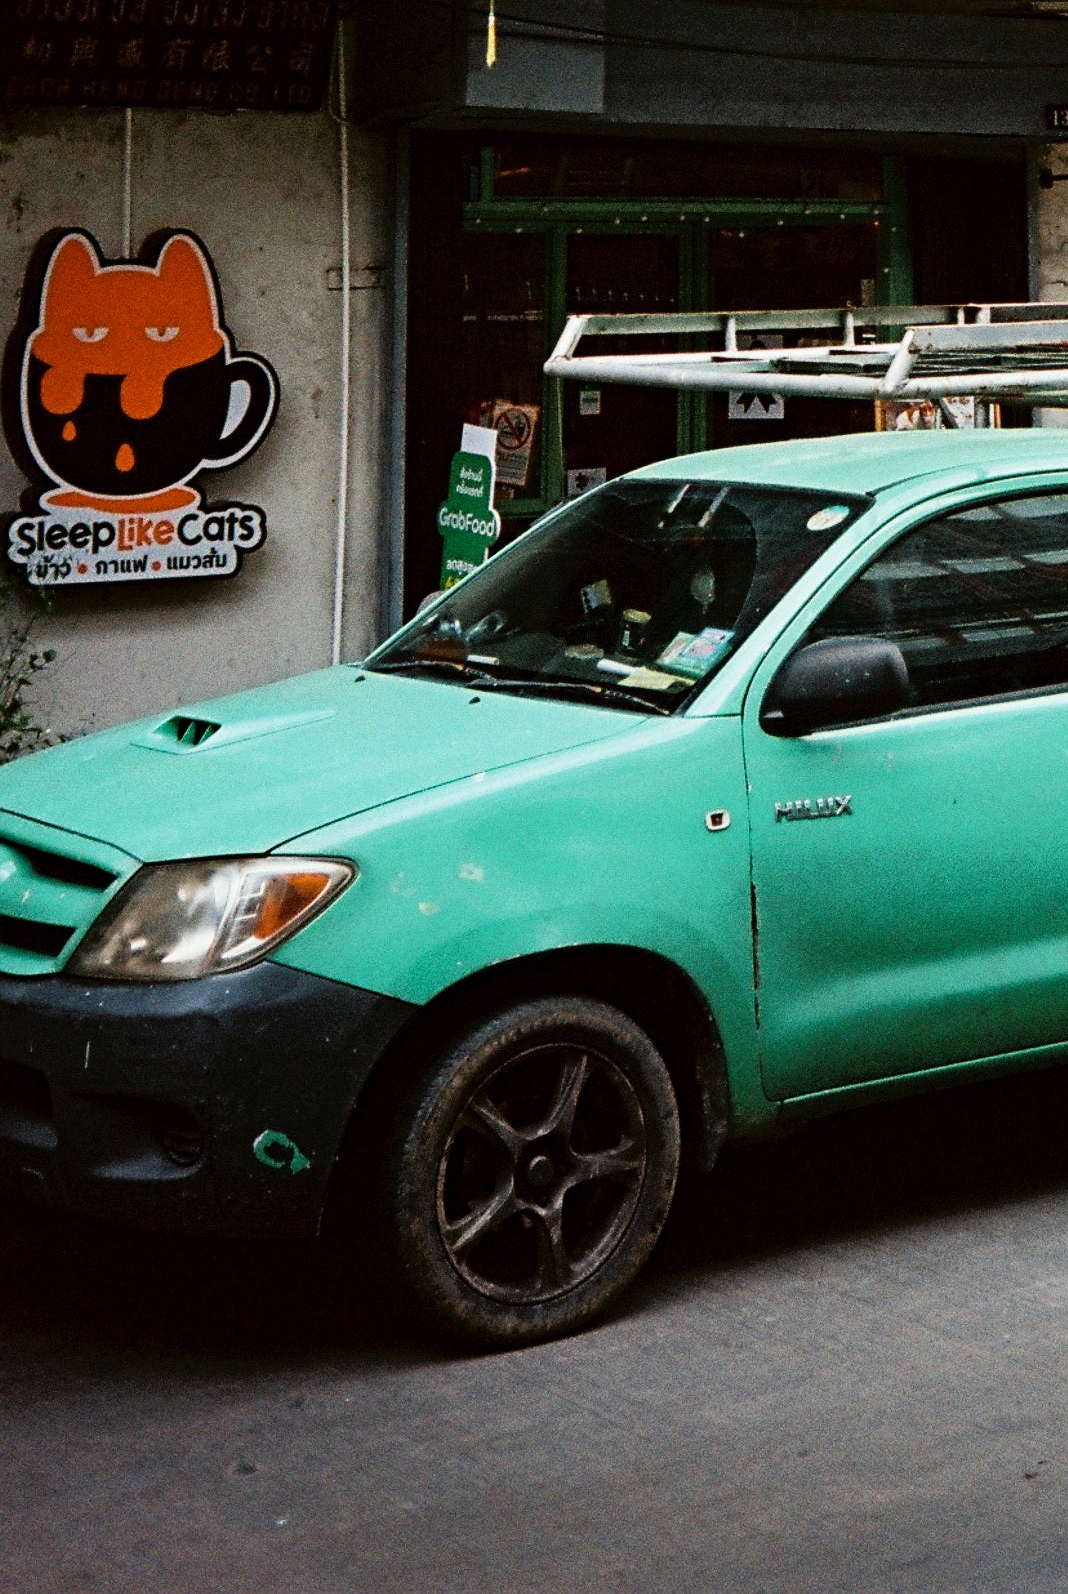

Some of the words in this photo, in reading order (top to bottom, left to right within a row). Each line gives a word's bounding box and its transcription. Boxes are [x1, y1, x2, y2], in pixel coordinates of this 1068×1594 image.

[439, 508, 495, 537] GrabFood
[95, 555, 147, 574] กาแฟ
[167, 548, 227, 570] แมวส้ม
[774, 795, 852, 823] HILUX
